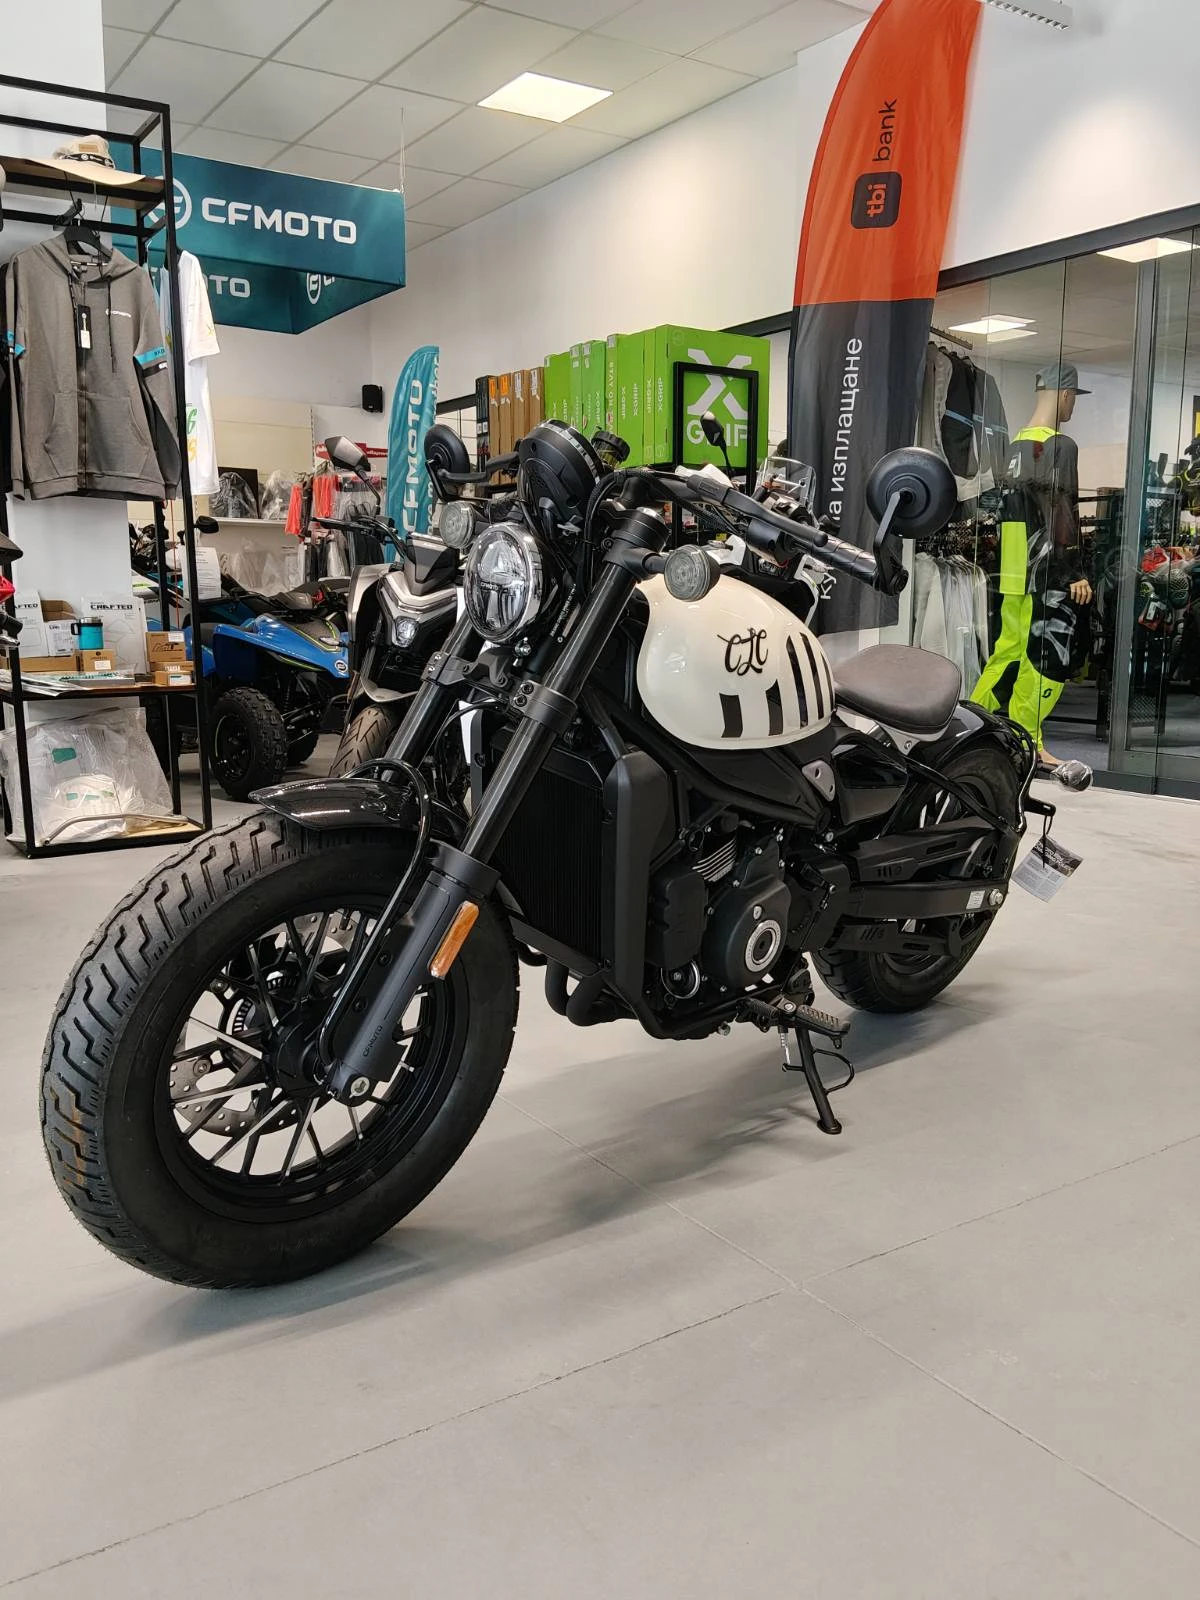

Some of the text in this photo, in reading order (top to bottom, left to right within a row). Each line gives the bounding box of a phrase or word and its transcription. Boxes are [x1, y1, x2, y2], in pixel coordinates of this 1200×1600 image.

[866, 99, 898, 218] tbi bank
[202, 197, 357, 245] CFMOTO
[402, 379, 424, 533] CFMOTO
[830, 337, 863, 492] изплащане
[828, 500, 843, 521] а
